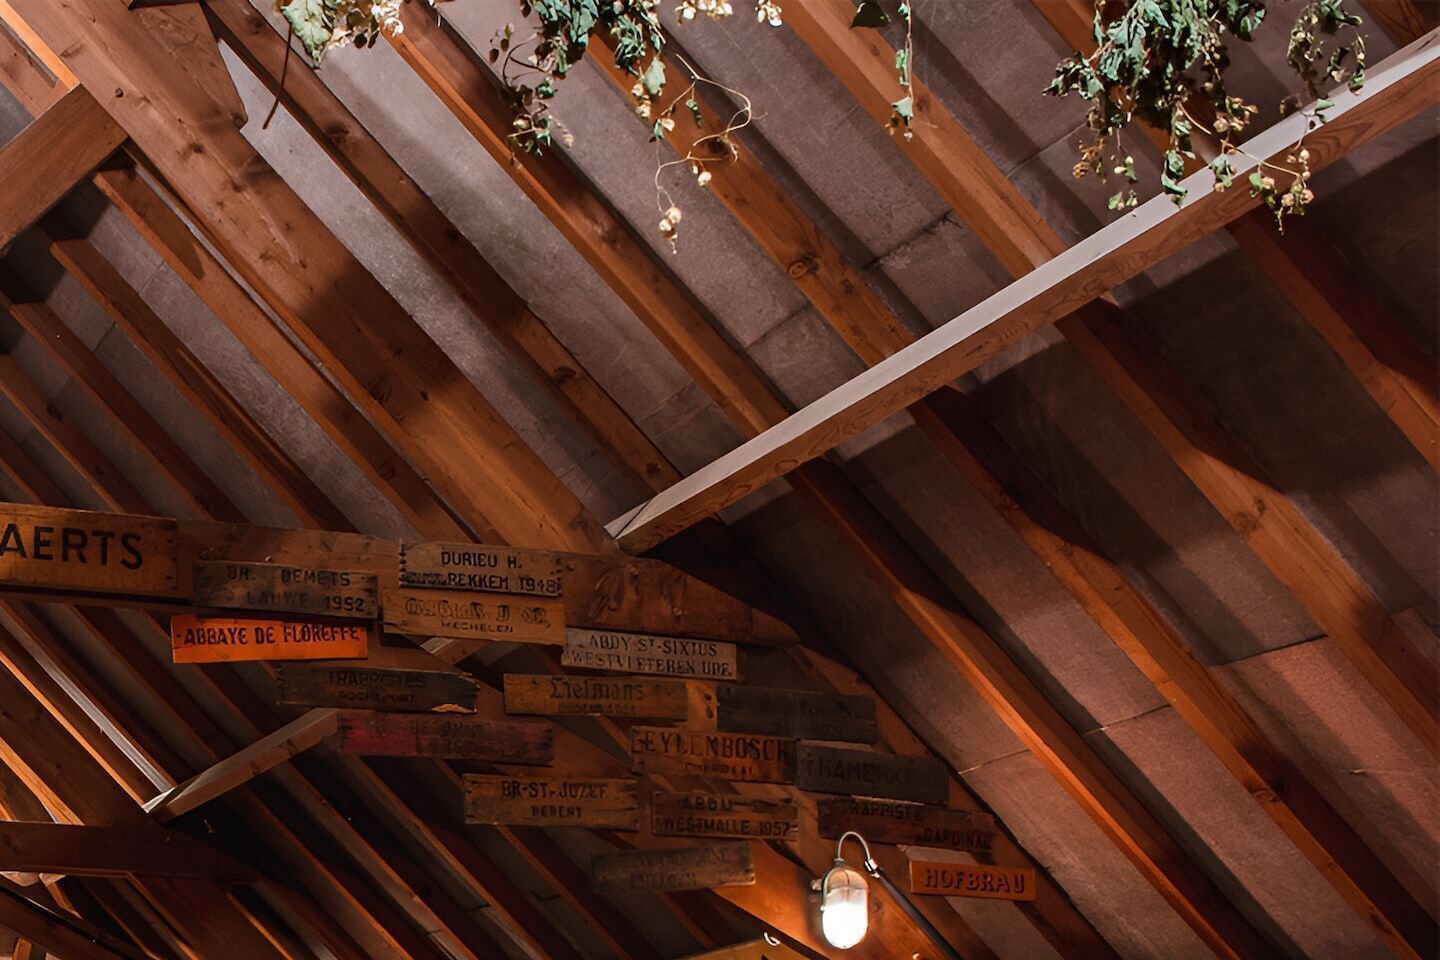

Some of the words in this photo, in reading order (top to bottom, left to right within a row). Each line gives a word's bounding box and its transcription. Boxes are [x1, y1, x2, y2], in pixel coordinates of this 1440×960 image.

[441, 551, 498, 569] DURIEU
[447, 572, 509, 590] REKKEM
[254, 627, 275, 644] DE
[283, 624, 360, 643] FLOREFFE
